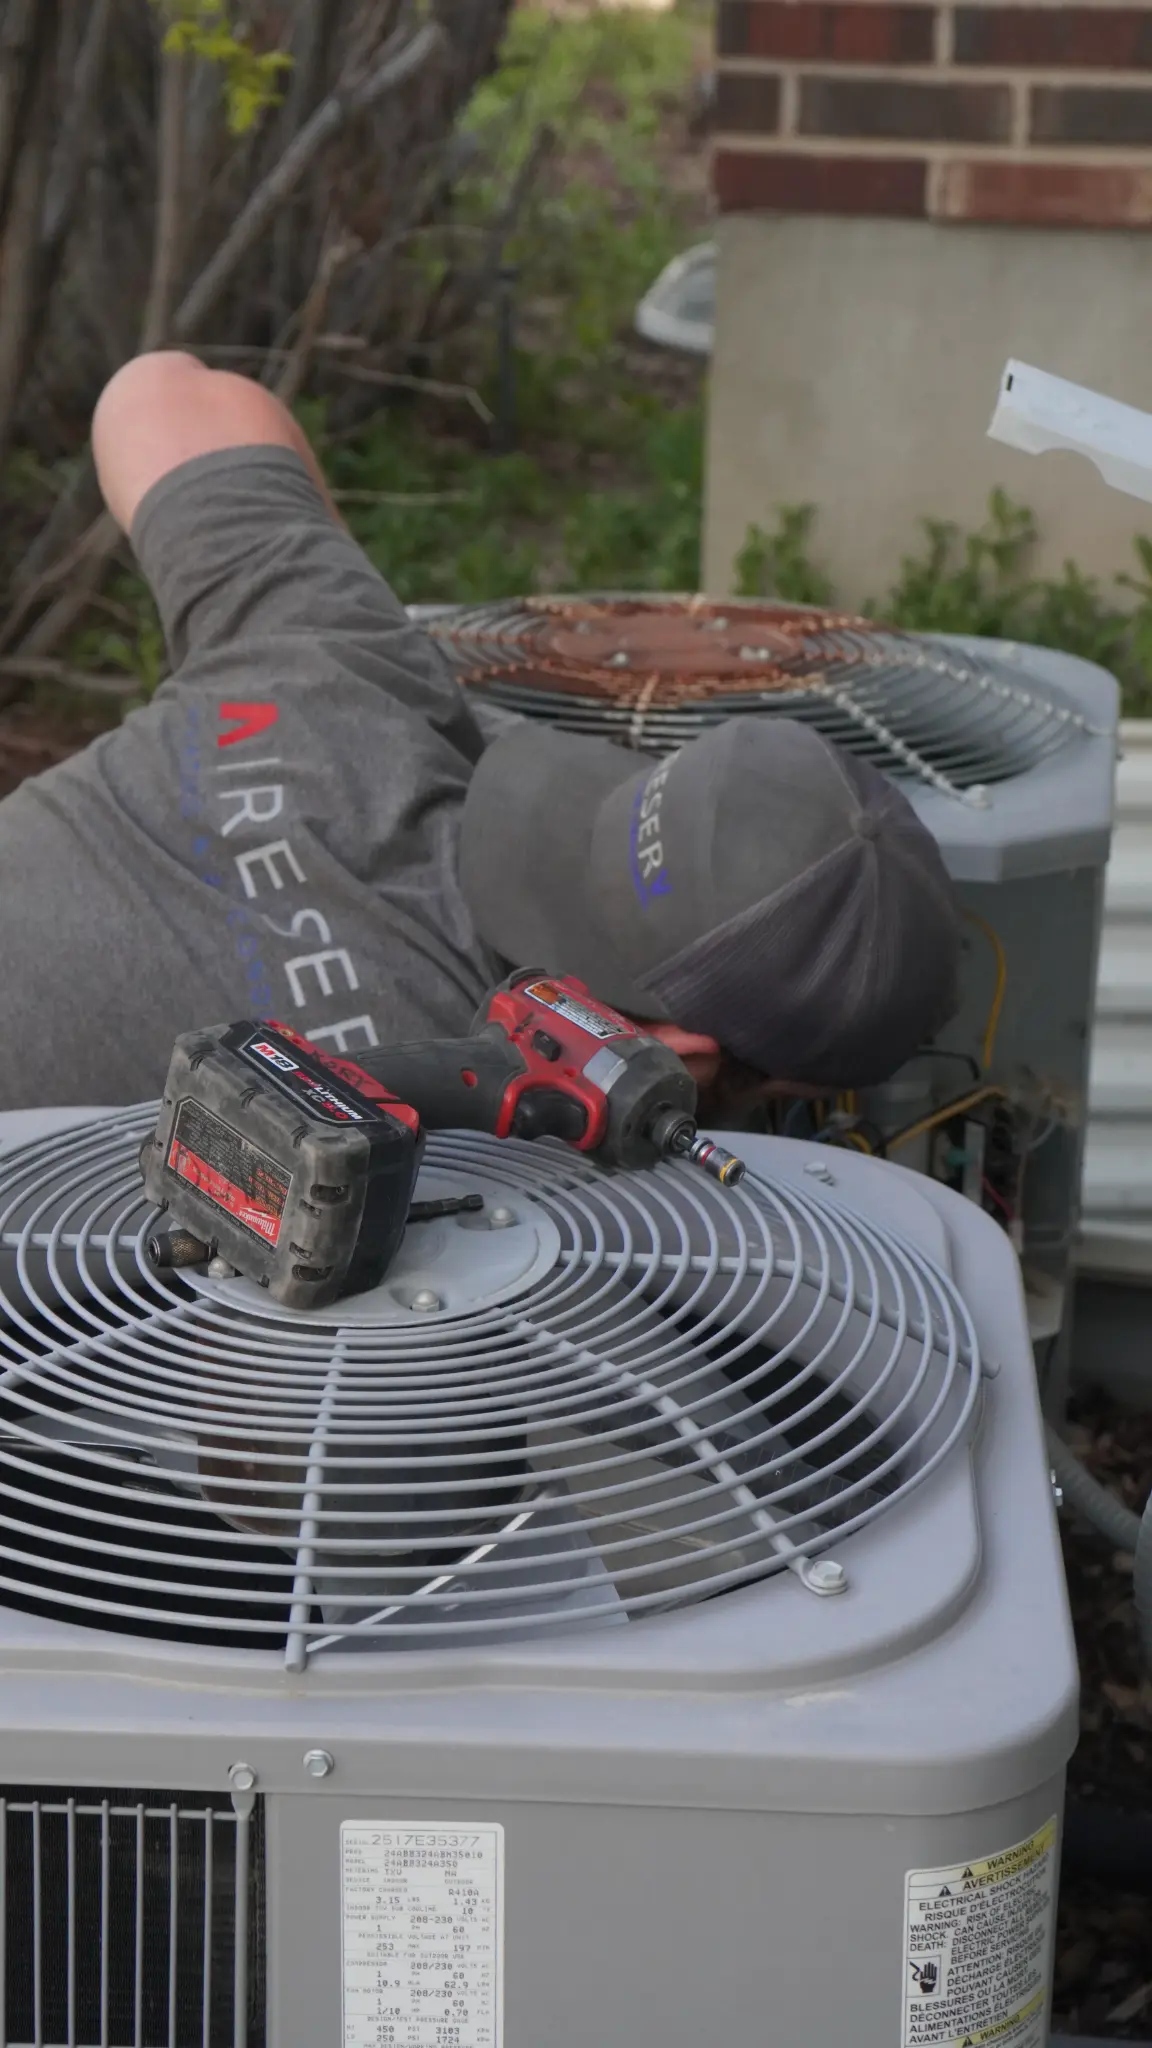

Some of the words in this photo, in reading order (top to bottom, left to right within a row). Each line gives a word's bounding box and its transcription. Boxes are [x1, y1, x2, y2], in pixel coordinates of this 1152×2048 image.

[254, 1043, 294, 1070] M18
[239, 1209, 276, 1236] Milwaukee
[372, 1834, 480, 1847] 2517E35377
[987, 1840, 1034, 1870] WARNING
[376, 1896, 400, 1904] 3.15
[454, 1898, 477, 1906] 1.43
[448, 1888, 480, 1897] R410A
[919, 1891, 987, 1911] ELECTRICAL
[990, 1877, 1021, 1896] SHOCK
[410, 1915, 453, 1924] 208-230
[462, 1907, 474, 1915] 10
[909, 1919, 961, 1933] WARNING:
[967, 1911, 987, 1924] RISK
[990, 1905, 1001, 1916] OF
[925, 1907, 967, 1922] RISQUE
[954, 1924, 974, 1936] CAN
[977, 1913, 1006, 1930] CAUSE
[952, 1921, 1007, 1946] DISCONNECT
[376, 1942, 394, 1951] 253
[454, 1944, 471, 1952] 197
[951, 1935, 996, 1955] ELECTRIC
[947, 1951, 1004, 1976] ATTENTION:
[951, 1948, 988, 1965] BEFORE
[410, 1961, 453, 1970] 208/230
[376, 1979, 401, 1987] 10.9
[444, 1981, 469, 1989] 62.9
[452, 1972, 465, 1980] 60
[410, 1989, 453, 1998] 208/230
[947, 1976, 992, 1997] POUVANT
[452, 1999, 465, 2007] 60
[910, 1993, 975, 2012] BLESSURES
[977, 1987, 991, 1999] OU
[994, 1981, 1006, 1992] LA
[376, 2007, 401, 2015] 1/10
[444, 2008, 469, 2017] 0.70
[910, 1999, 989, 2023] DÉCONNECTER
[909, 2007, 992, 2033] ALIMENTATIONS
[909, 2031, 945, 2044] AVANT
[948, 2009, 1008, 2037] L'ENTRETIEN
[980, 2014, 1020, 2041] WARNING
[376, 2025, 395, 2033] 450
[435, 2026, 460, 2035] 3103
[376, 2034, 395, 2042] 250
[436, 2035, 460, 2044] 1724
